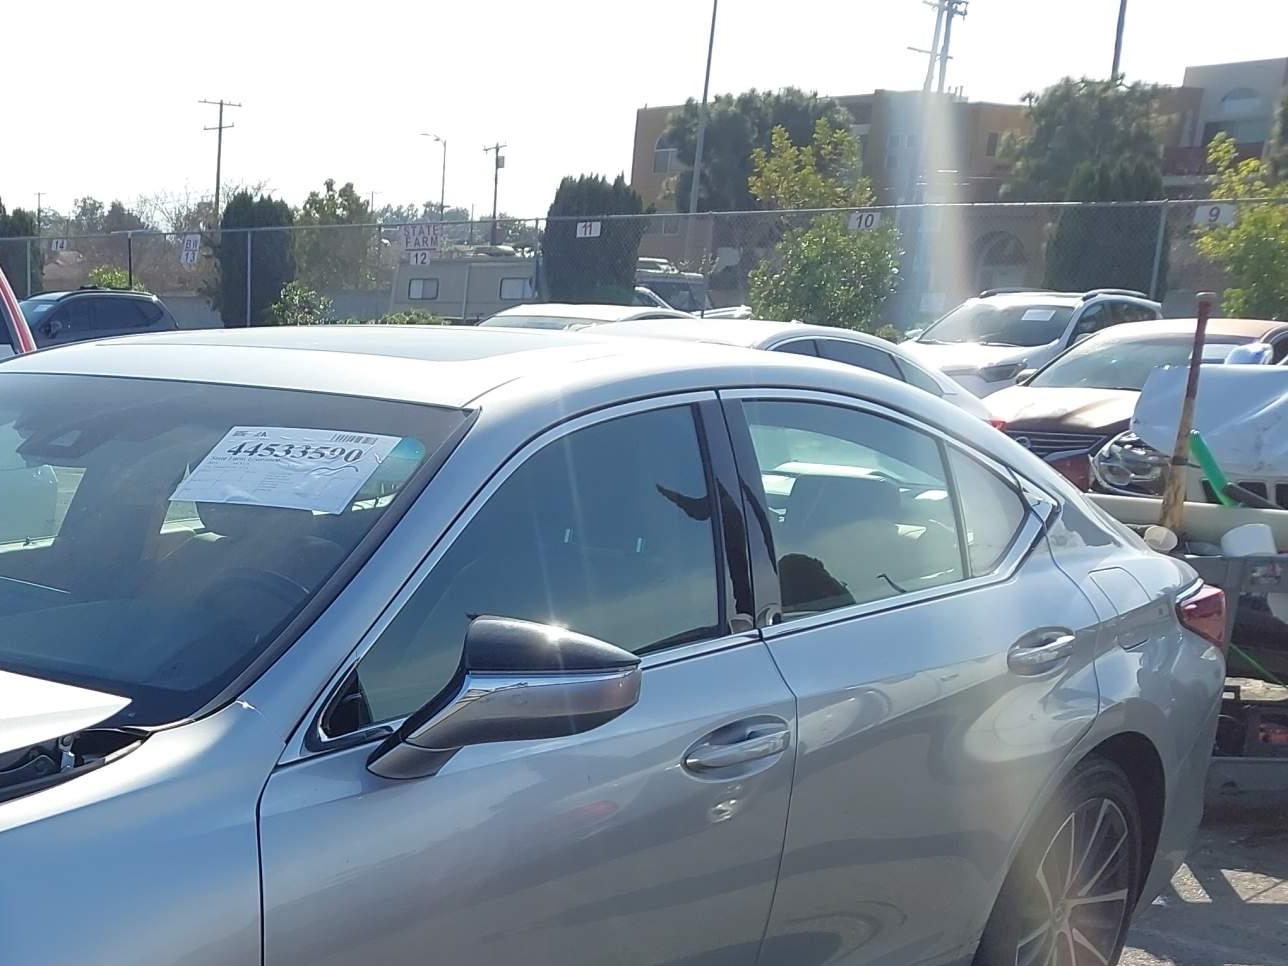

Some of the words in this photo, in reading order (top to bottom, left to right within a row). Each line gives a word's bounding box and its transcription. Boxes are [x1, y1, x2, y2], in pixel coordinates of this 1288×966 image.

[856, 213, 874, 228] 10
[1208, 206, 1220, 222] 9
[403, 225, 439, 237] STATE
[582, 223, 592, 236] 11
[405, 236, 439, 248] FARM
[414, 252, 427, 265] 12
[226, 441, 364, 463] 44533590
